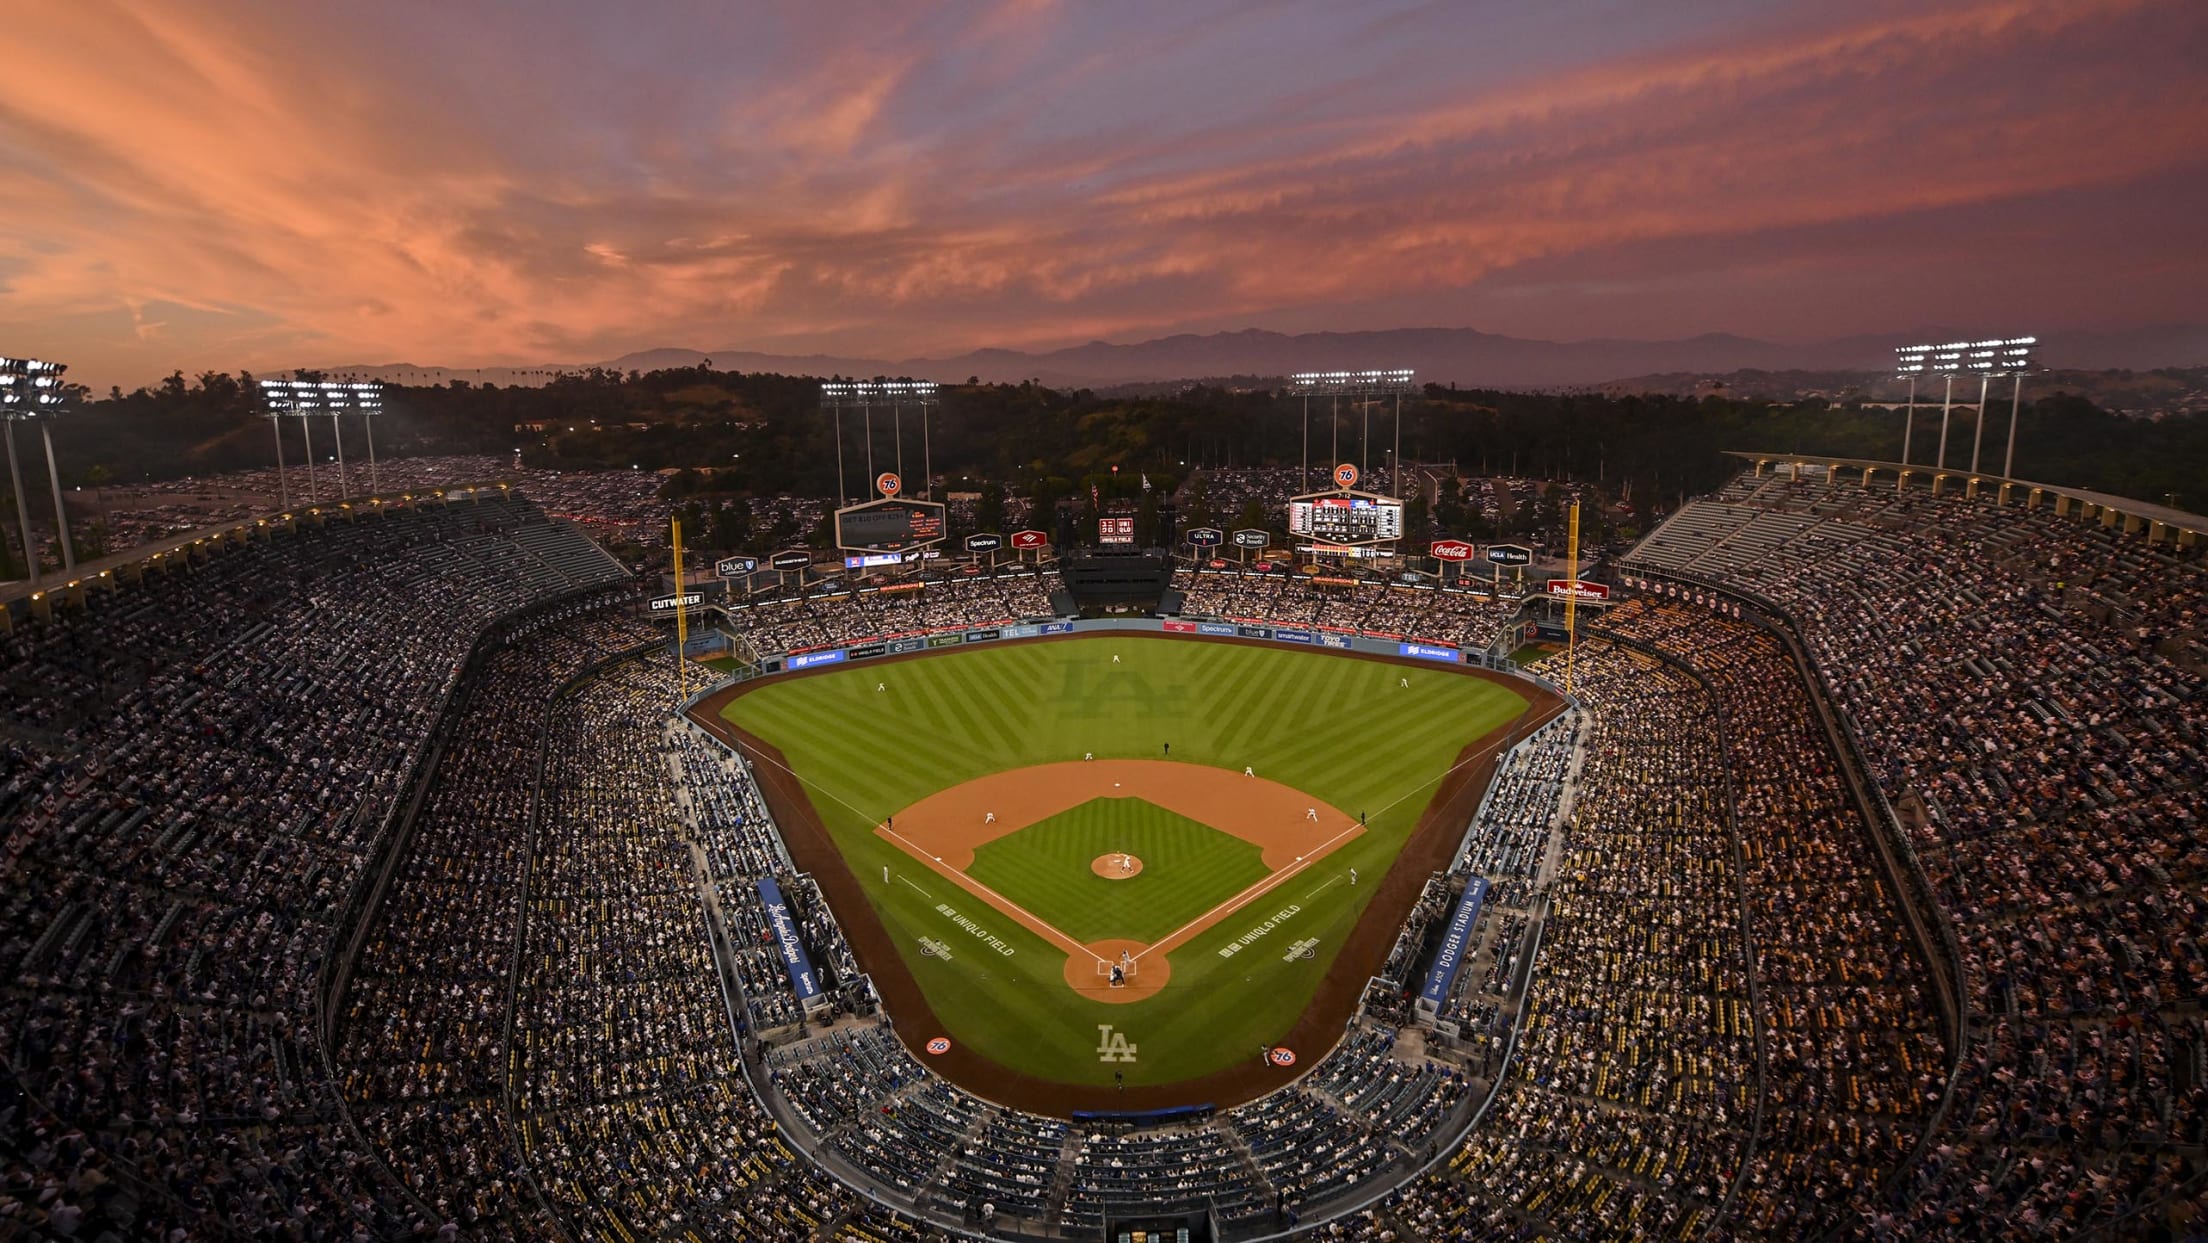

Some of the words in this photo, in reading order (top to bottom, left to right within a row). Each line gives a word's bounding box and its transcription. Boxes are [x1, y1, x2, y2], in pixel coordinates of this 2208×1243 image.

[1340, 470, 1353, 480] 76
[883, 479, 897, 490] 76
[1246, 533, 1265, 541] Security
[970, 539, 996, 547] Spectrum
[1489, 551, 1505, 559] UCLA
[1506, 552, 1528, 561] Health
[721, 562, 744, 572] blue
[1553, 585, 1602, 598] Budweiser
[651, 595, 700, 609] CUTWATER
[1004, 629, 1019, 637] TEL
[1201, 625, 1230, 633] Spectrum
[1278, 633, 1309, 641] smartwater
[809, 653, 837, 663] ELDRIDGE
[1420, 649, 1450, 657] ELDRIDGE
[1238, 921, 1275, 945] UNIQLO
[1271, 904, 1301, 924] FIELD
[952, 914, 987, 938] UNIQLO
[983, 935, 1015, 956] FIELD
[1440, 934, 1461, 967] DODGER
[1454, 901, 1475, 932] STADIUM
[782, 935, 800, 964] Dodgers
[930, 1041, 947, 1050] 76
[1097, 1024, 1137, 1062] LA
[1275, 1051, 1292, 1061] 76
